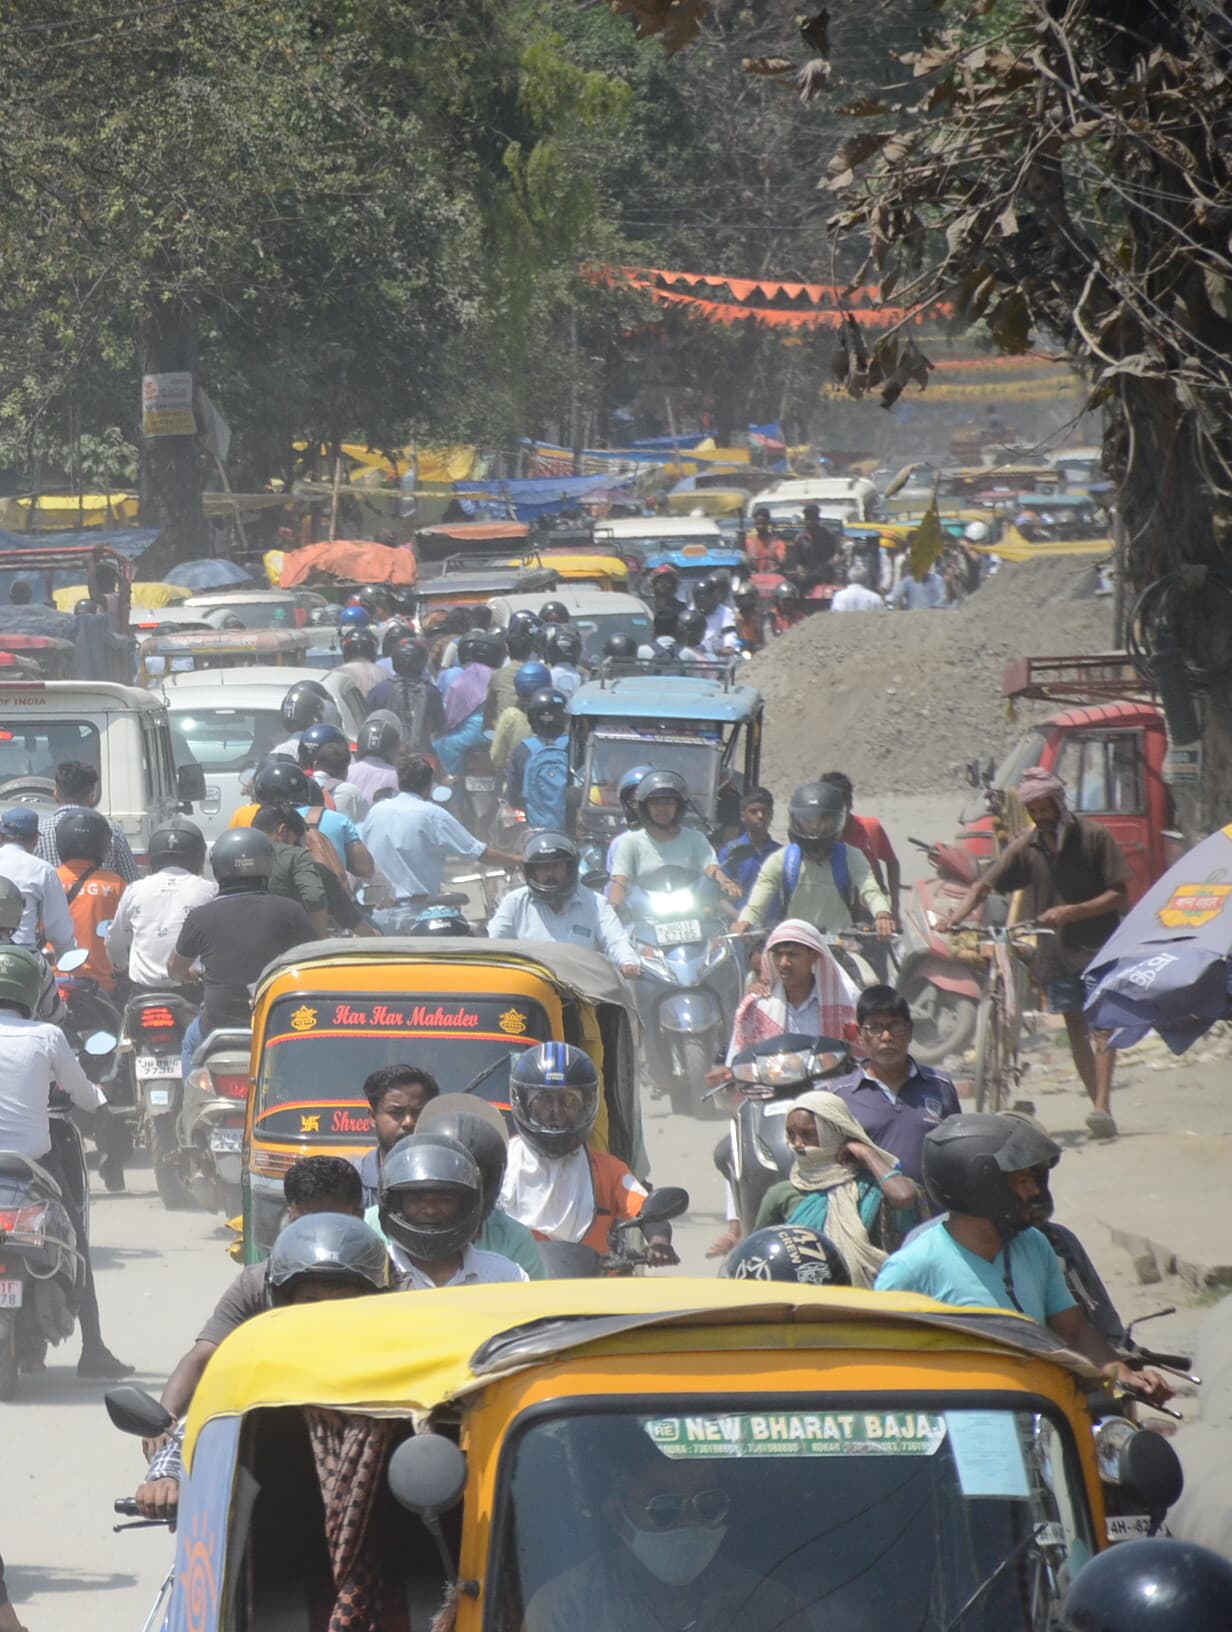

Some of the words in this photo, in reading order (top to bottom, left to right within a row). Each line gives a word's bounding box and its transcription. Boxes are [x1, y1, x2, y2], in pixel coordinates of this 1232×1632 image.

[14, 698, 47, 706] INDIA
[332, 1006, 367, 1026] Har
[369, 1006, 404, 1026] Har
[405, 1006, 479, 1027] Mahadev
[778, 1231, 802, 1264] CREW
[686, 1417, 742, 1441] NEW
[751, 1415, 854, 1440] BHARAT
